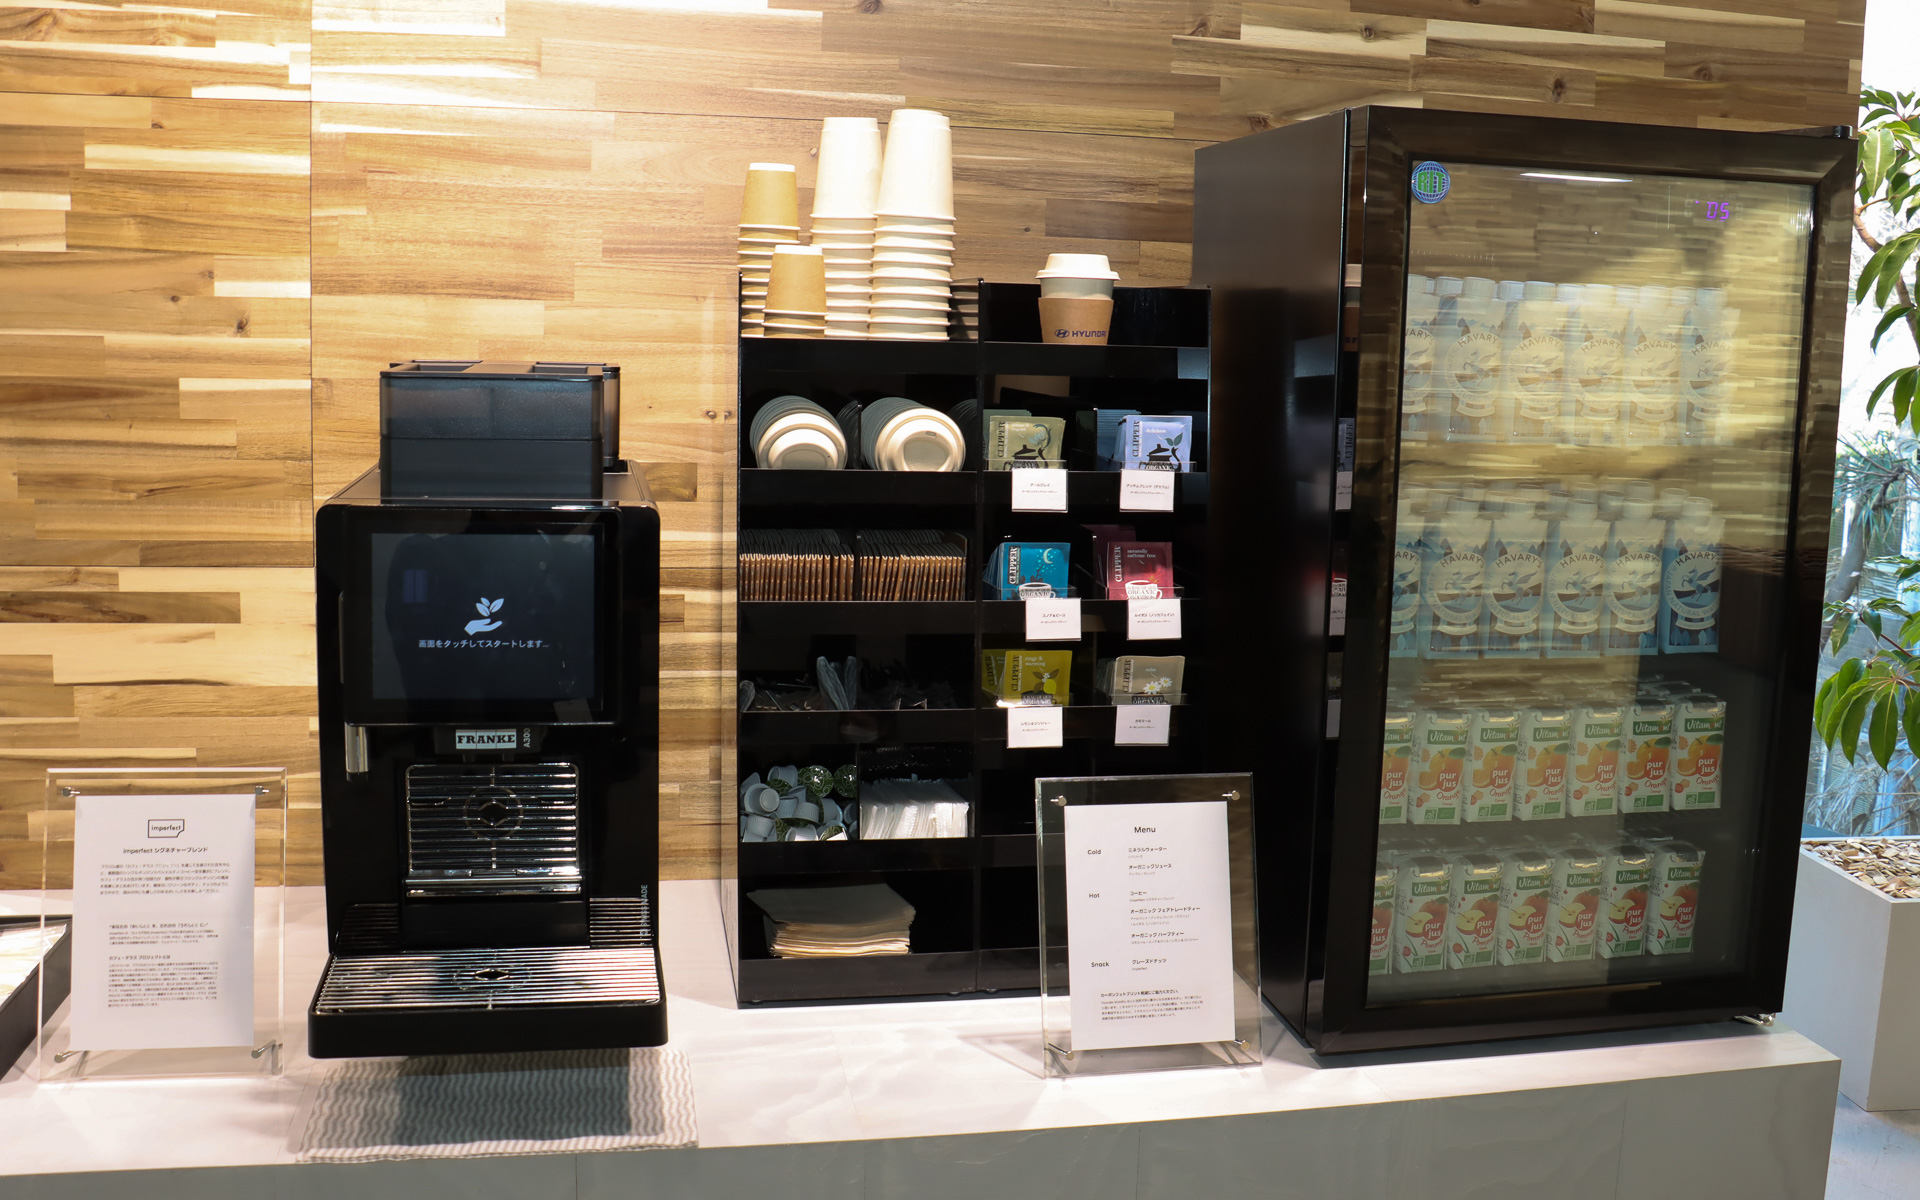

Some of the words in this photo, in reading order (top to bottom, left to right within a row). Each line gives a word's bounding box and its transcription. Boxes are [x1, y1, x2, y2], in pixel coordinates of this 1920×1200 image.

[1706, 201, 1730, 220] 05
[997, 421, 1005, 458] CLIPPER
[1132, 420, 1140, 457] CLIPPER
[1114, 546, 1122, 582] CLIPPER
[1440, 552, 1485, 569] HAVARY'S
[1495, 553, 1543, 569] HAVARY'S
[1560, 553, 1604, 568] HAVARY'S
[1675, 552, 1720, 566] HAVARY'S
[1009, 547, 1017, 584] CLIPPER
[1011, 655, 1019, 691] CLIPPER
[1123, 659, 1131, 693] CLIPPER
[457, 734, 516, 744] FRANKE
[523, 728, 531, 748] A300
[1646, 761, 1663, 770] pur
[1698, 758, 1715, 767] pur
[1492, 769, 1509, 779] pur
[1545, 768, 1561, 778] pur
[1597, 764, 1614, 774] pur
[1649, 768, 1663, 778] jus
[1701, 765, 1715, 774] jus
[1386, 771, 1403, 781] pur
[1440, 773, 1456, 782] pur
[1495, 776, 1509, 786] jus
[1548, 775, 1561, 785] jus
[1600, 771, 1614, 781] jus
[1696, 774, 1719, 785] Orange
[1389, 779, 1403, 789] jus
[1442, 779, 1457, 790] jus
[1595, 781, 1617, 792] Orange
[1644, 777, 1668, 789] Orange
[1383, 788, 1407, 800] Orange
[1489, 786, 1512, 797] Orange
[1542, 784, 1566, 796] Orange
[1436, 790, 1460, 801] Orange
[151, 824, 181, 832] imperfect
[1134, 826, 1156, 834] Menu
[1627, 909, 1642, 918] pur
[1677, 906, 1692, 916] pur
[1527, 916, 1543, 925] pur
[1577, 913, 1592, 922] pur
[1629, 916, 1642, 925] jus
[1680, 913, 1692, 922] jus
[1425, 922, 1441, 931] pur
[1477, 920, 1492, 929] pur
[1530, 923, 1543, 932] jus
[1580, 920, 1592, 930] jus
[1672, 922, 1693, 932] Pomme
[1428, 929, 1441, 939] jus
[1479, 926, 1492, 936] jus
[1572, 929, 1595, 938] Pomme
[1622, 925, 1643, 935] Pomme
[1372, 934, 1386, 944] jus
[1472, 936, 1495, 946] Pomme
[1522, 932, 1544, 941] Pomme
[1421, 939, 1443, 949] Pomme
